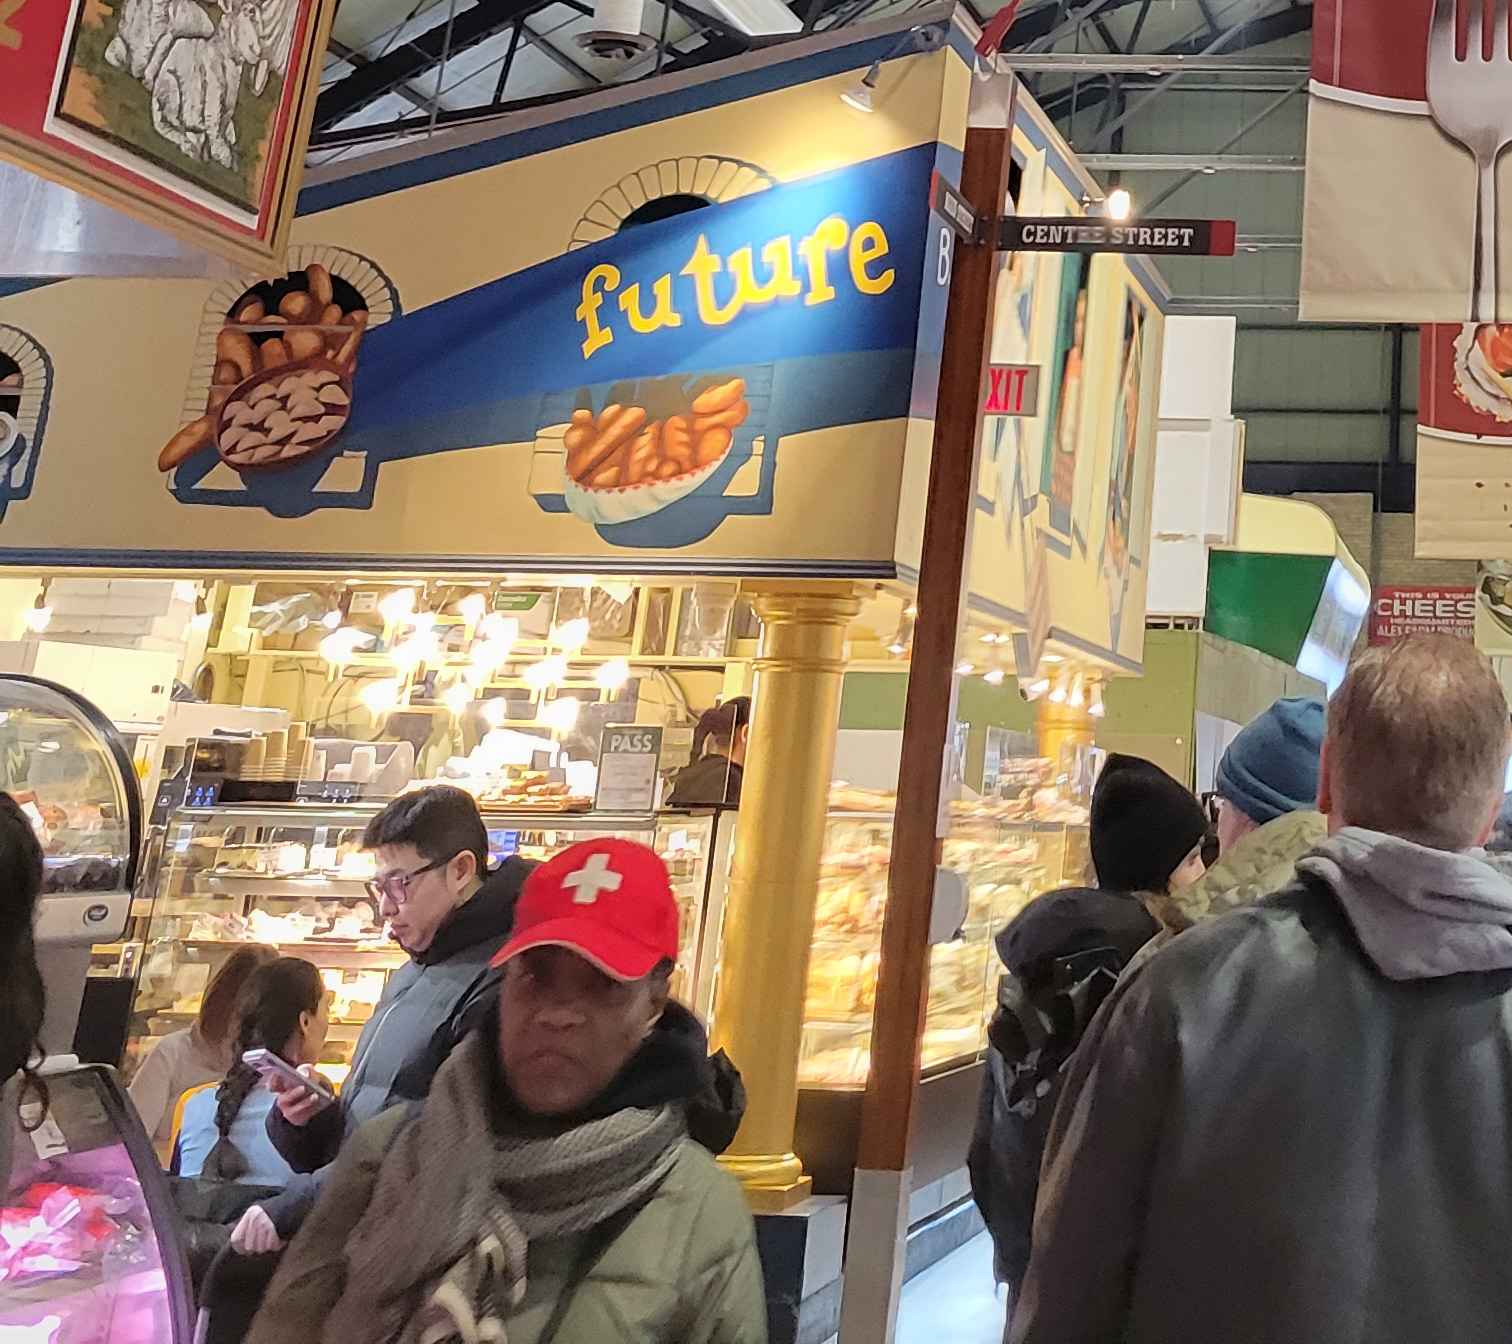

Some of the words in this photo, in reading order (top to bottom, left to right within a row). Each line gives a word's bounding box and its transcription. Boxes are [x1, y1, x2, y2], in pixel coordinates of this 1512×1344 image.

[1022, 224, 1105, 245] CENTRE
[1111, 226, 1194, 247] STREET
[575, 213, 895, 360] future
[610, 733, 654, 753] PASS
